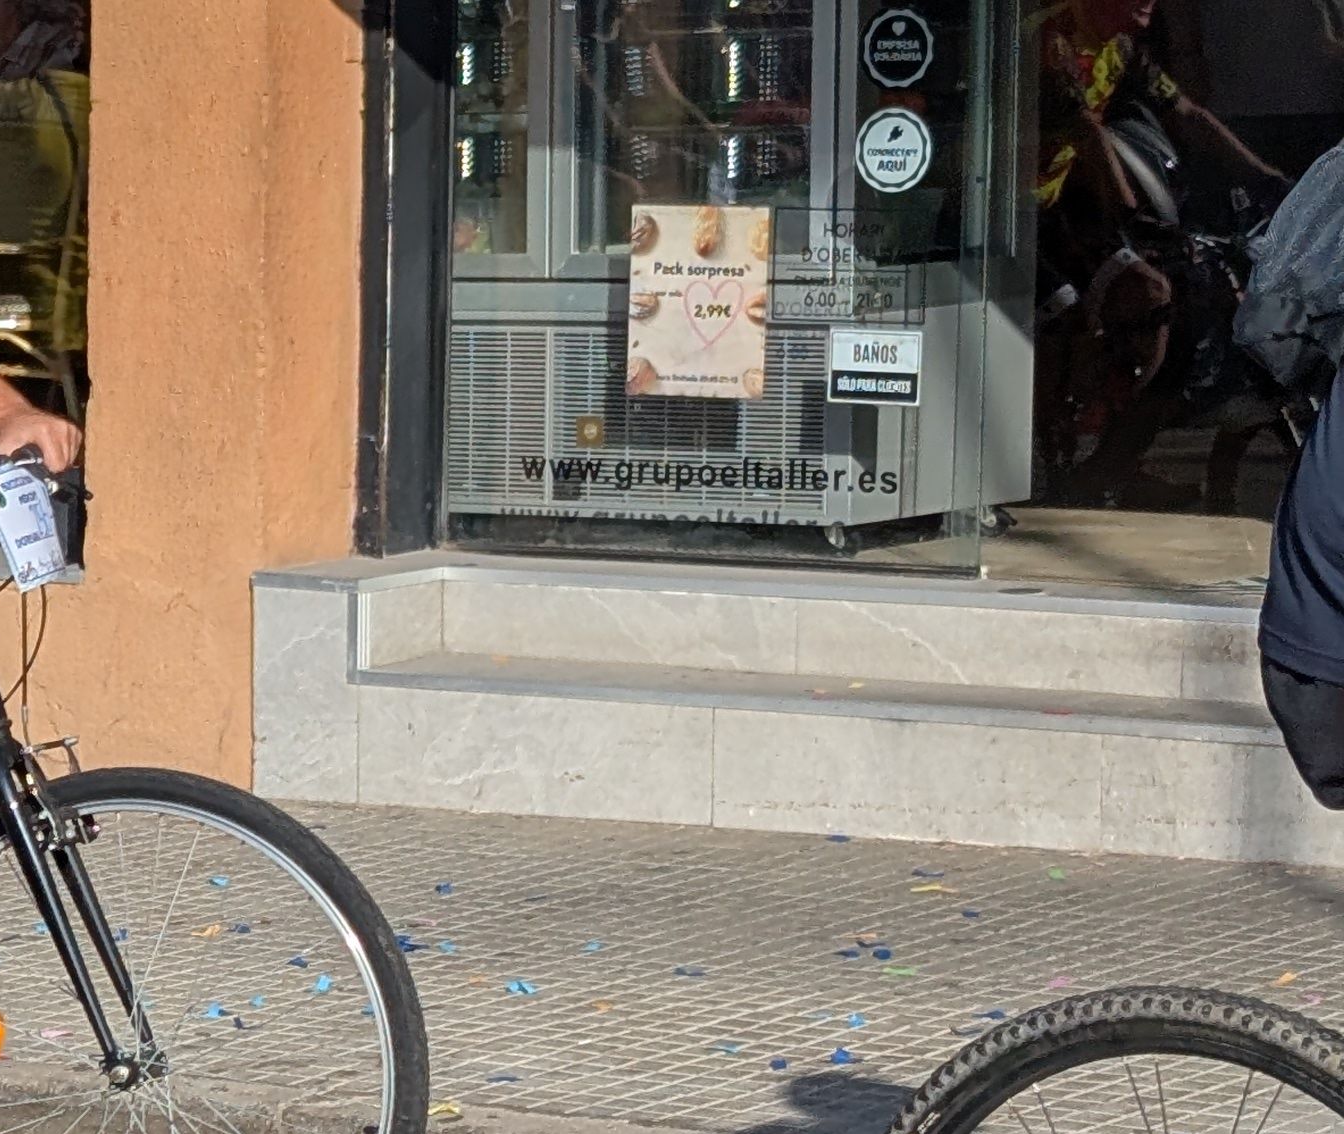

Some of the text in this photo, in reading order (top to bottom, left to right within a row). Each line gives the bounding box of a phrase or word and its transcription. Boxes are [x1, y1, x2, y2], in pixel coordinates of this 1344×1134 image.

[877, 157, 907, 172] AQUÍ
[654, 262, 745, 280] Pack sorpresa
[694, 304, 731, 319] 2,99€
[853, 341, 898, 364] BAÑOS
[521, 455, 899, 494] www.grupoeltaller.es
